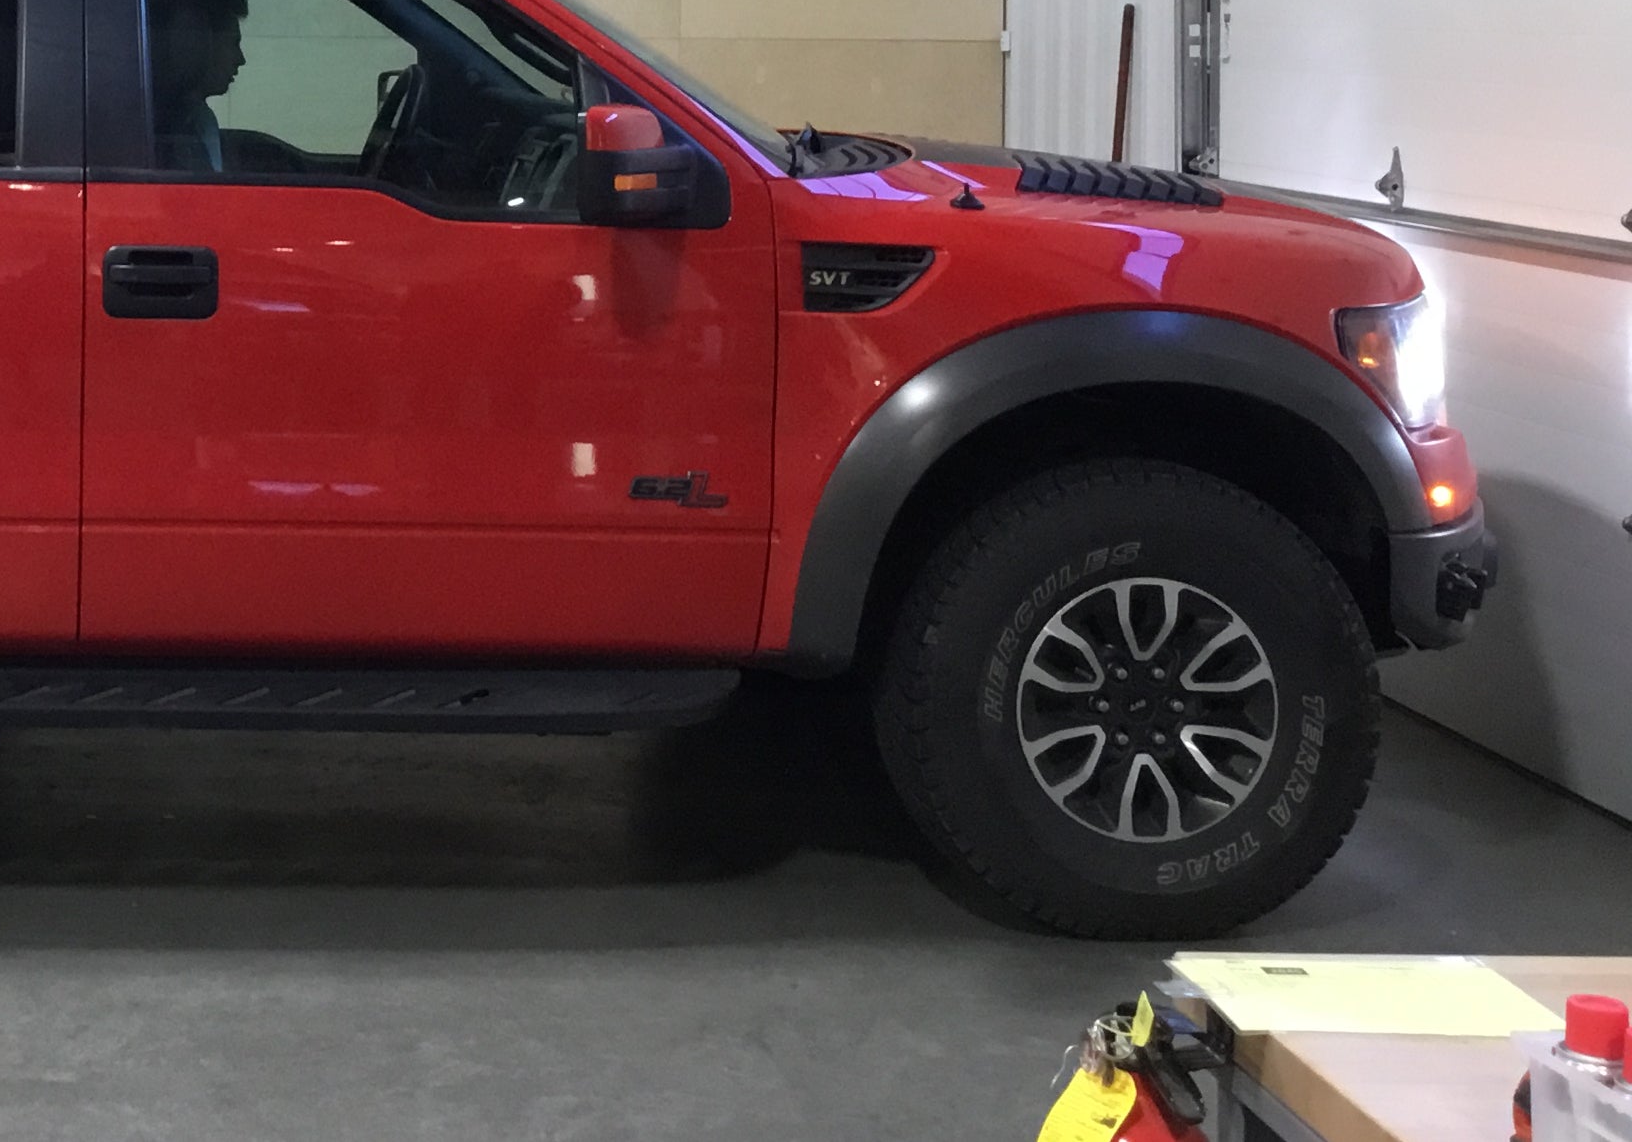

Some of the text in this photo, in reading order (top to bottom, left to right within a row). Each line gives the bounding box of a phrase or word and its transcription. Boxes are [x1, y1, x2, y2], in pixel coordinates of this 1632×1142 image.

[809, 270, 851, 286] SVT
[983, 542, 1142, 723] HERCULES
[1155, 694, 1326, 886] TERRA TRAC
